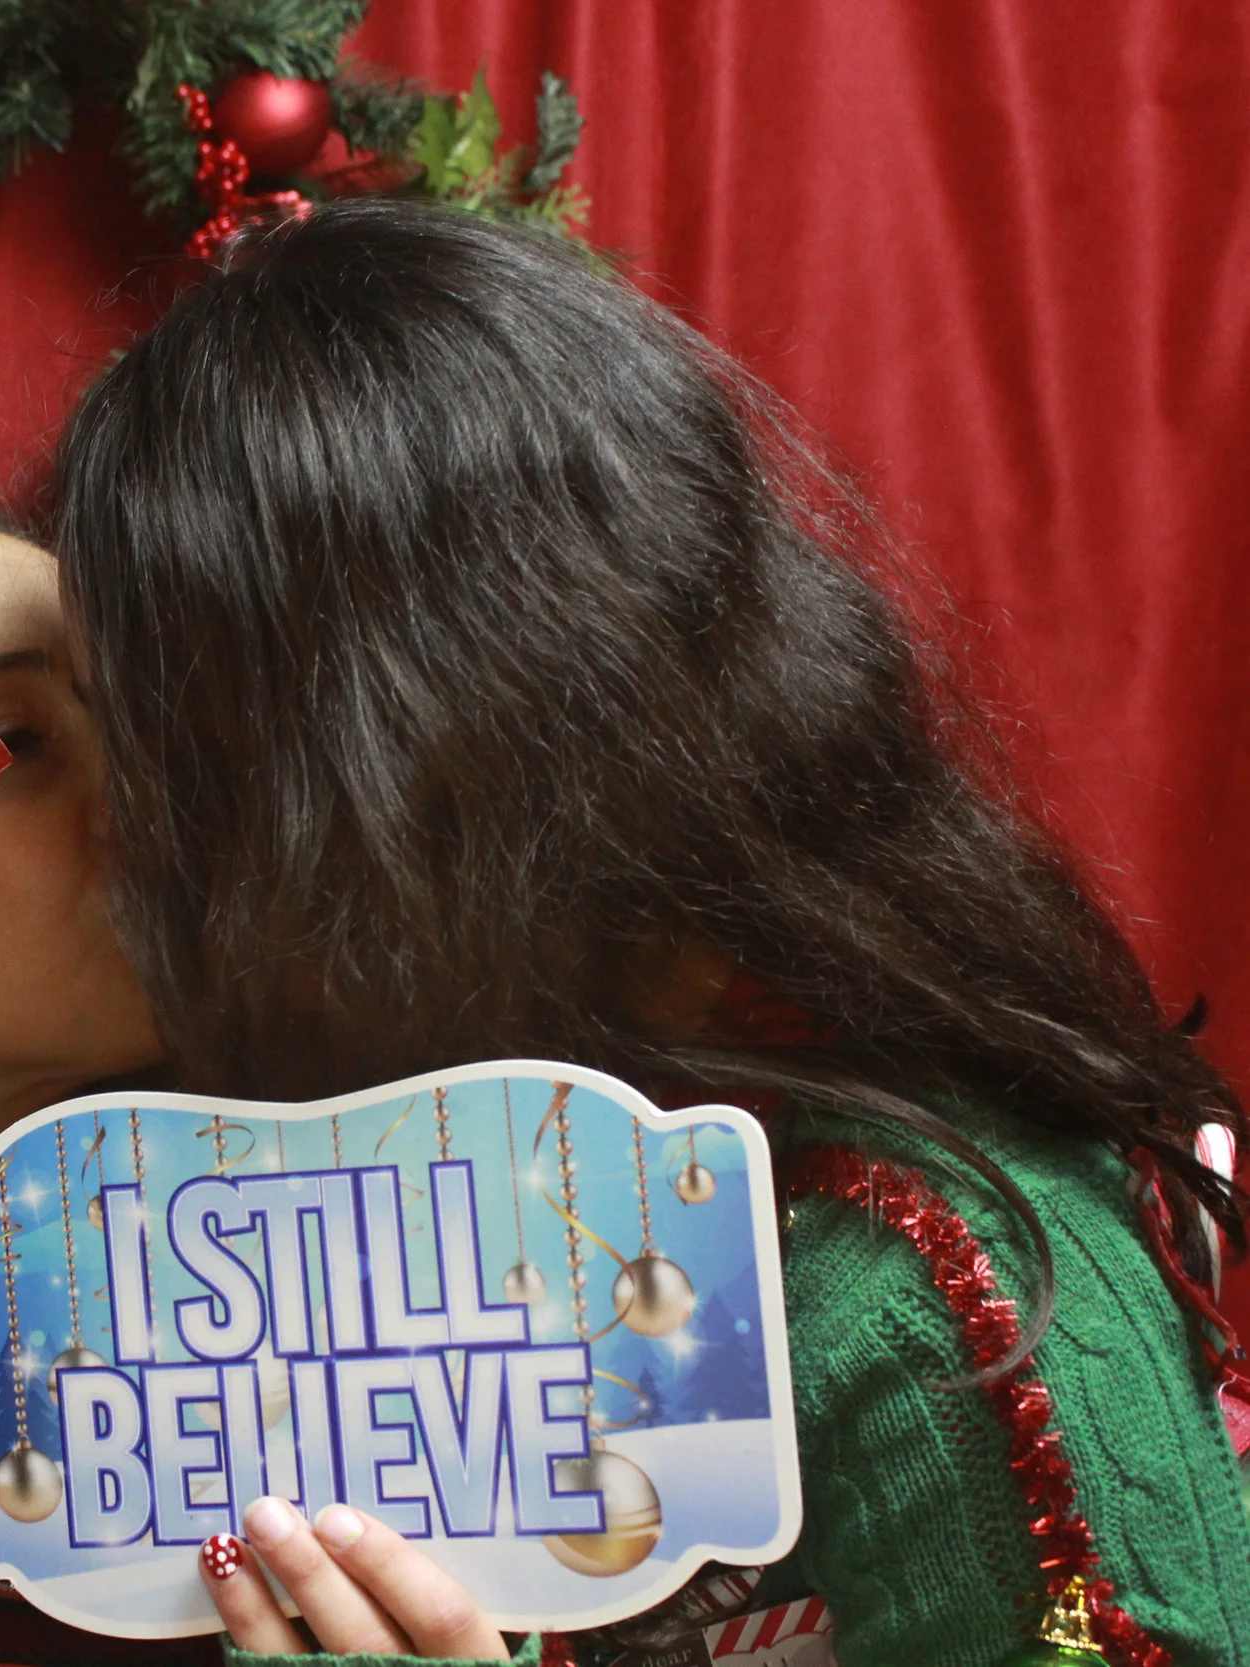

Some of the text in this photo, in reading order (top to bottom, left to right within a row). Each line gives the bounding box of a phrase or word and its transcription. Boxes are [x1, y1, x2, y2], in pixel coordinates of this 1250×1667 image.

[100, 1158, 530, 1366] I STILL
[55, 1342, 606, 1549] BELIEVE
